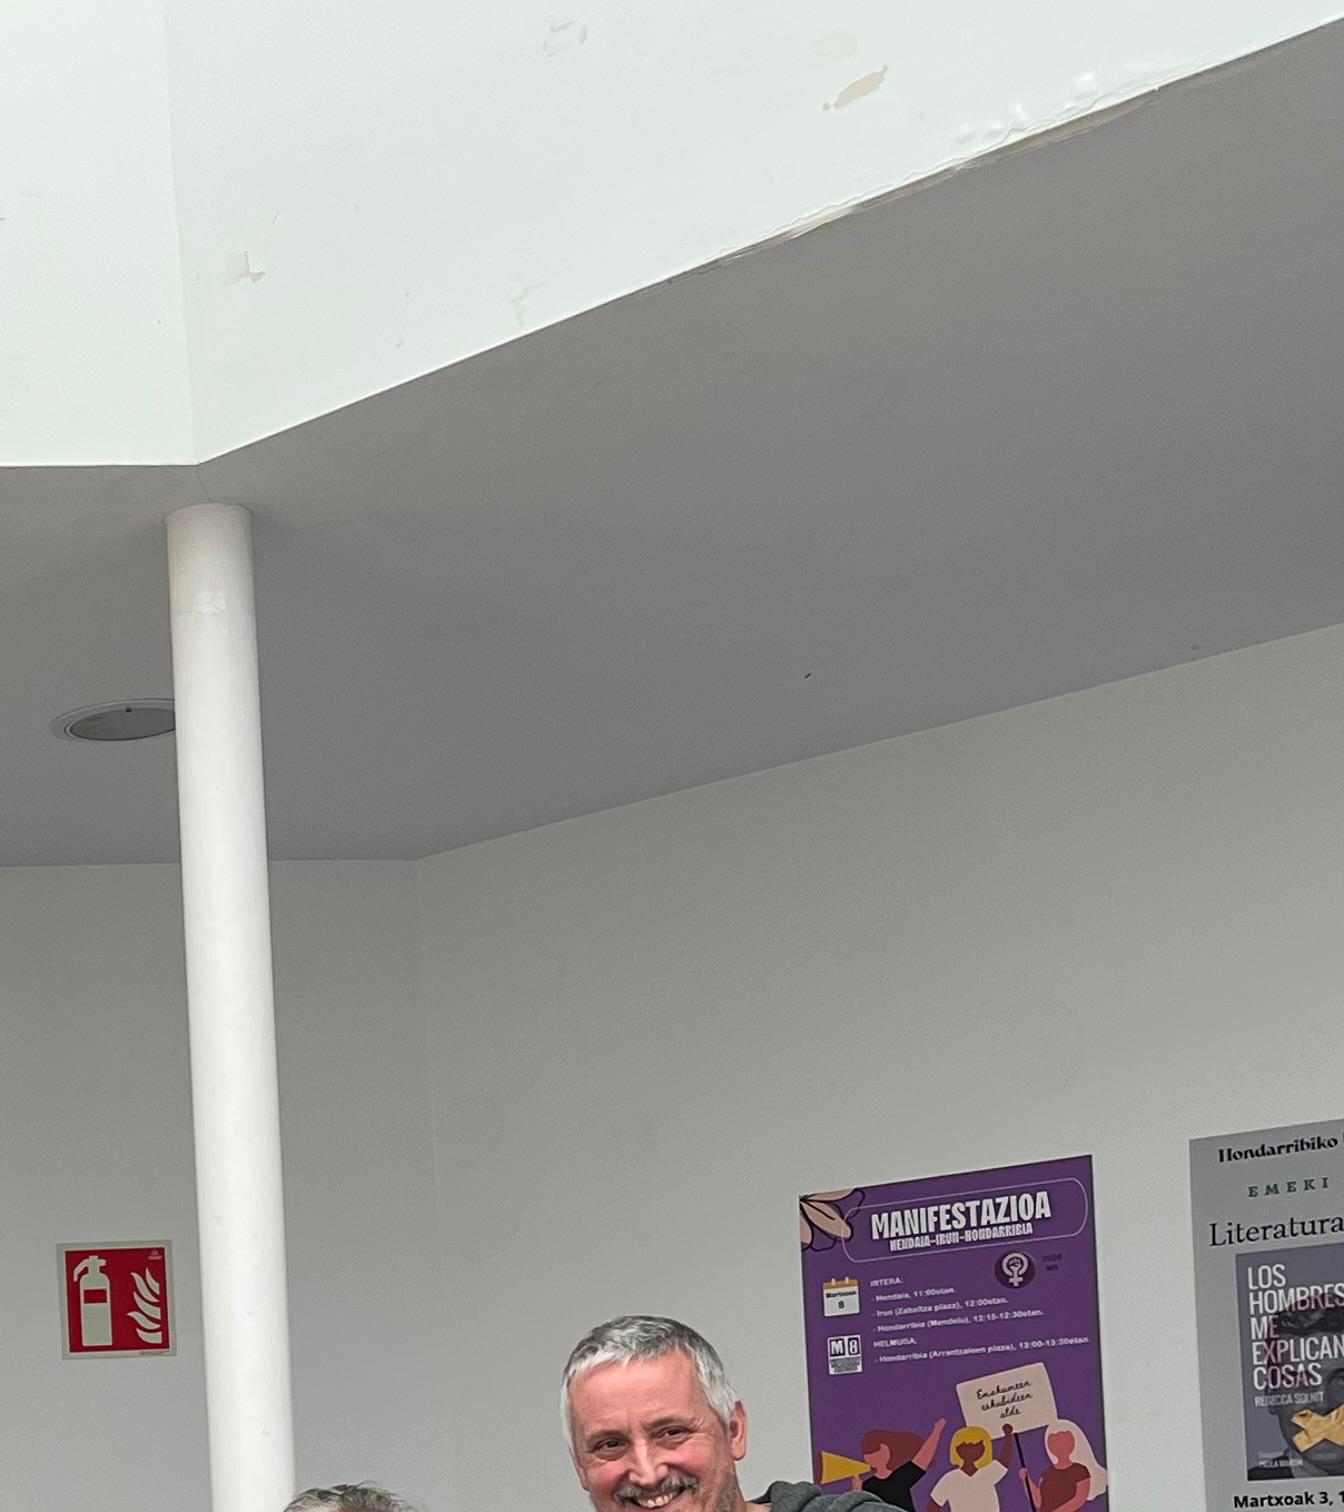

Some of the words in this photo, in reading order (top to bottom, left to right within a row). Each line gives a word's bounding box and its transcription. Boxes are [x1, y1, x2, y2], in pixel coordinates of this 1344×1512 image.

[1218, 1136, 1338, 1164] Hondarribiko
[870, 1191, 1052, 1240] MANIFESTAZIOA
[1209, 1216, 1344, 1248] Literatura
[1247, 1263, 1286, 1290] LOS
[1249, 1282, 1344, 1316] HOMBRES
[1250, 1314, 1279, 1340] ME
[831, 1340, 844, 1355] M
[848, 1339, 858, 1354] 8
[1252, 1334, 1344, 1366] EXPLICAN
[1253, 1363, 1322, 1390] COSAS
[1234, 1492, 1315, 1509] Martxoak
[1319, 1491, 1334, 1506] 3,
